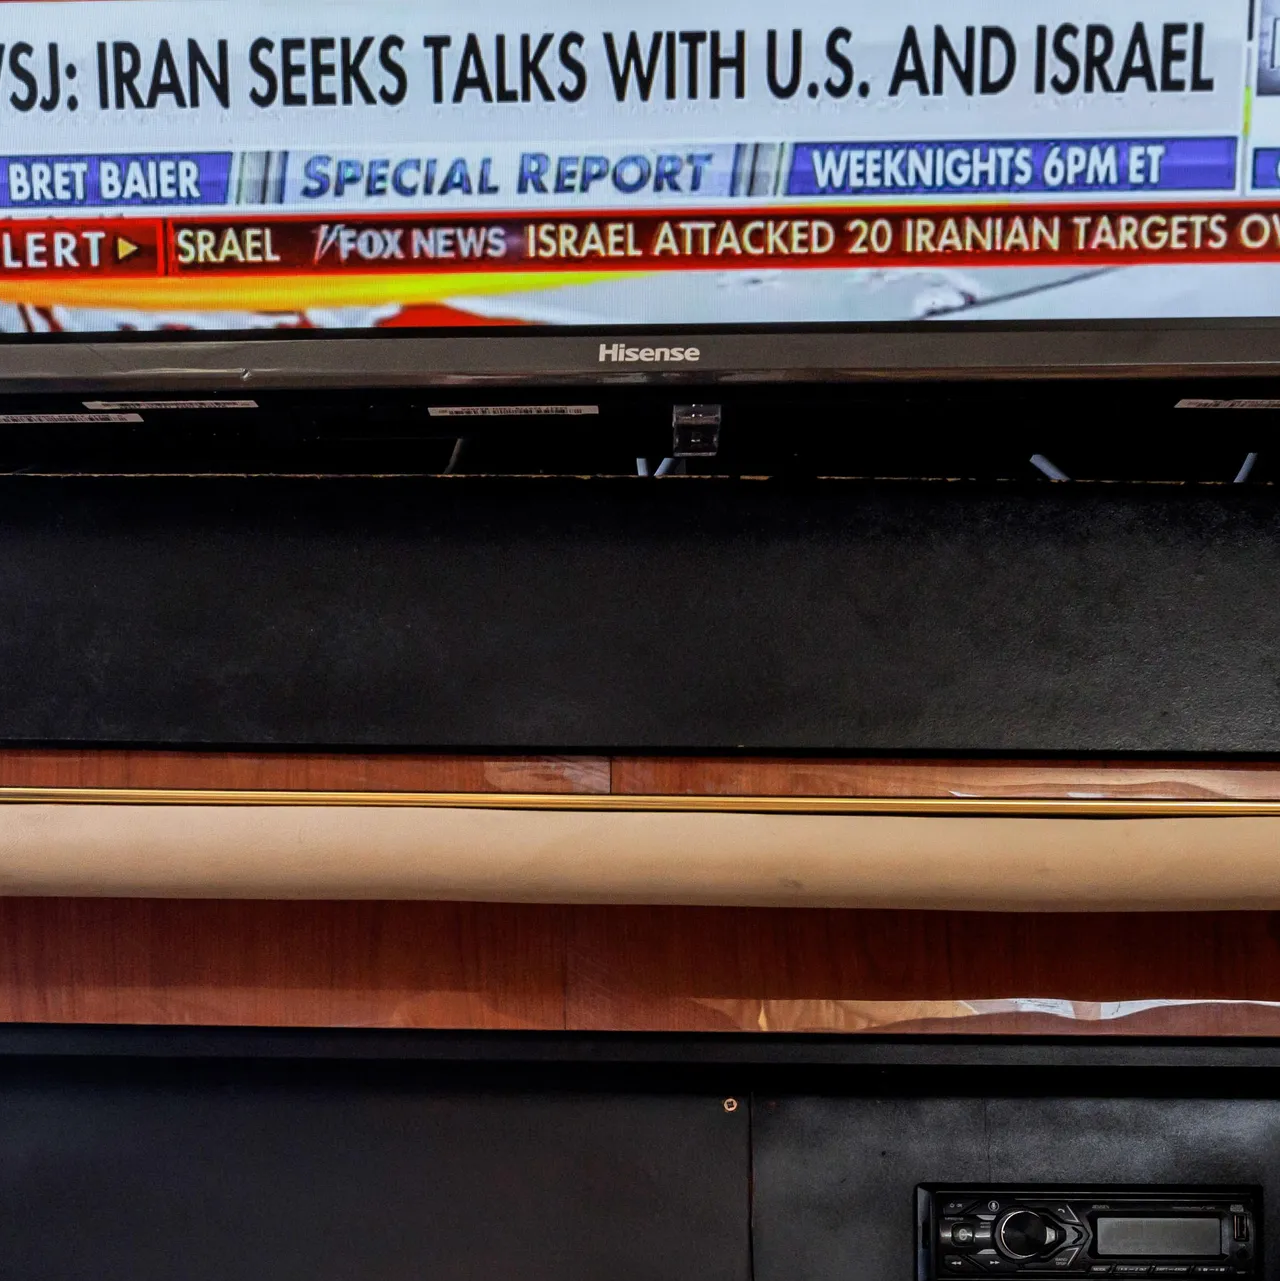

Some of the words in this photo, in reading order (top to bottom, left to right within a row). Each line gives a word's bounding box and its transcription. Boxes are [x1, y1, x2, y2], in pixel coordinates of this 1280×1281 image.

[97, 36, 230, 109] IRAN
[248, 34, 408, 108] SEEKS
[423, 32, 587, 103] TALKS
[603, 29, 746, 101] WITH
[766, 26, 870, 99] U.S.
[888, 24, 1017, 97] AND
[1035, 21, 1215, 95] ISRAEL
[8, 162, 89, 201] BRET
[100, 160, 201, 199] BAIER
[300, 154, 500, 198] SPECIAL
[519, 151, 715, 195] REPORT
[812, 146, 1031, 189] WEEKNIGHTS
[1043, 145, 1118, 186] 6PM
[1128, 144, 1166, 184] ET
[338, 227, 402, 259] FOX
[413, 226, 507, 258] NEWS
[527, 222, 643, 258] ISRAEL
[654, 219, 835, 256] ATTACKED
[848, 219, 892, 253] 20
[906, 216, 1060, 252] IRANIAN
[1073, 214, 1226, 250] TARGETS
[599, 344, 700, 361] Hisense
